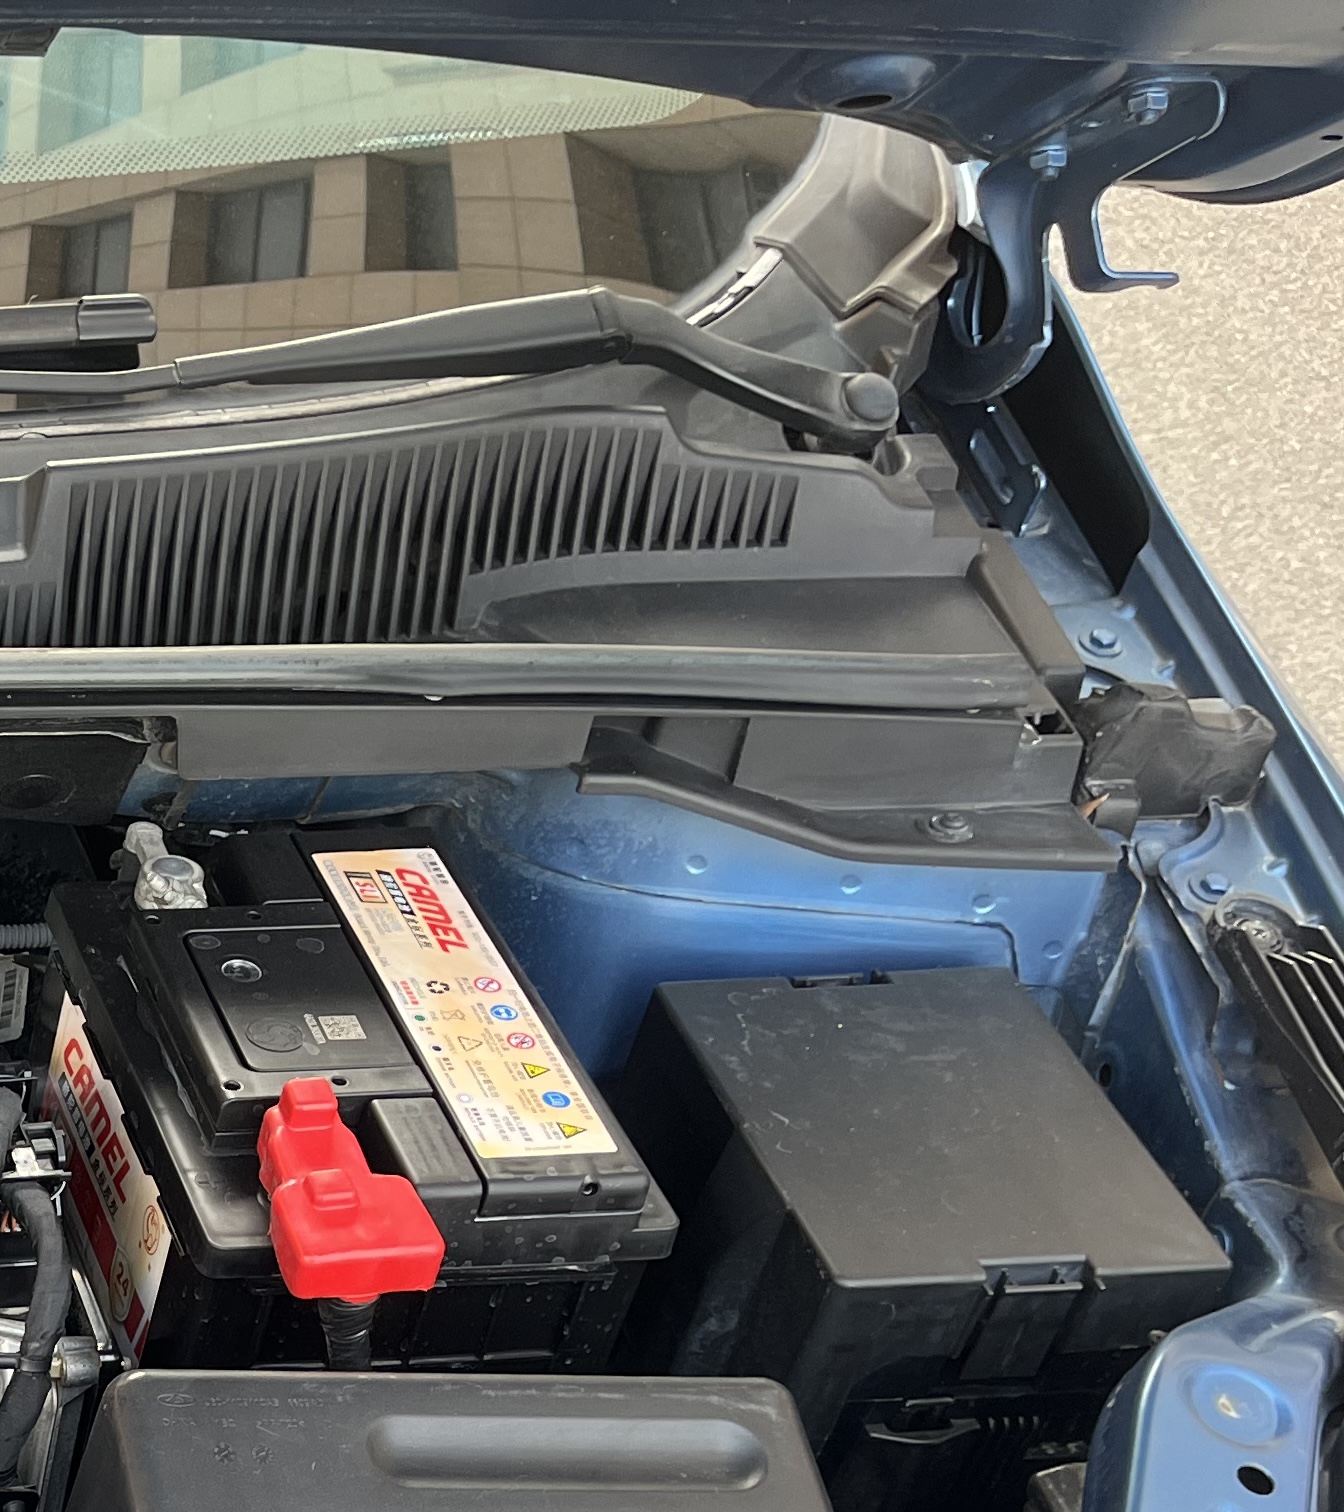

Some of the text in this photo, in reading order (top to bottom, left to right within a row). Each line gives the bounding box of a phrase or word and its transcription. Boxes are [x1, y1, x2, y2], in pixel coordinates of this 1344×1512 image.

[395, 867, 469, 953] CAMEL
[64, 1038, 130, 1204] CAMEL
[116, 1262, 130, 1297] 24
